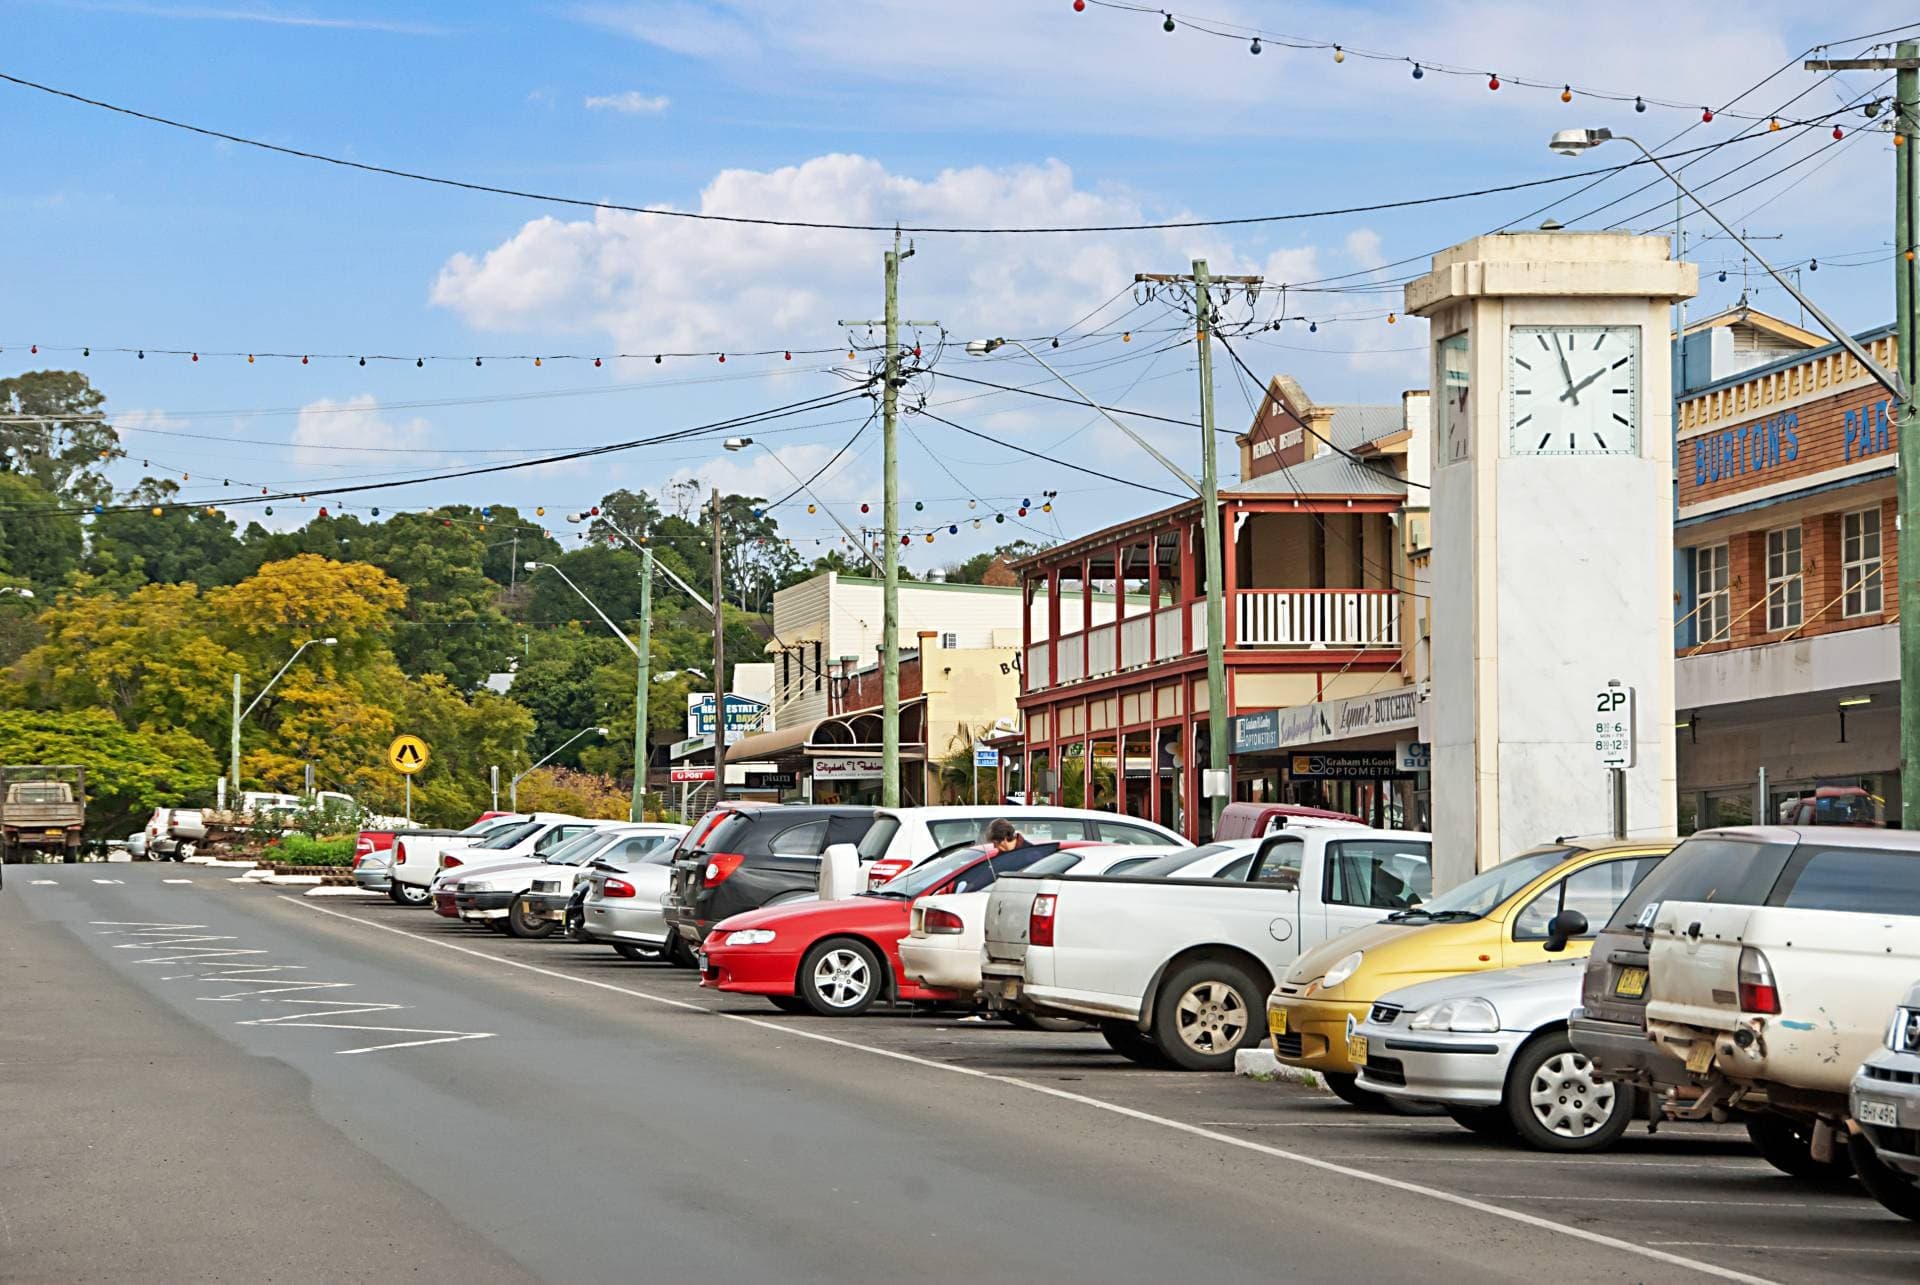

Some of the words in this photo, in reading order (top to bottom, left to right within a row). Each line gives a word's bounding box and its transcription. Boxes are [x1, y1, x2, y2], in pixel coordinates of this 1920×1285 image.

[1695, 412, 1799, 487] BURTON'S
[1844, 396, 1898, 462] PAR
[1375, 691, 1416, 723] BUTCHERY
[1597, 692, 1626, 712] 2P
[701, 704, 717, 713] REA
[726, 704, 759, 713] ESTATE
[727, 714, 732, 723] 7
[1326, 757, 1360, 766] Graham
[685, 772, 704, 780] POST
[762, 773, 790, 785] plum
